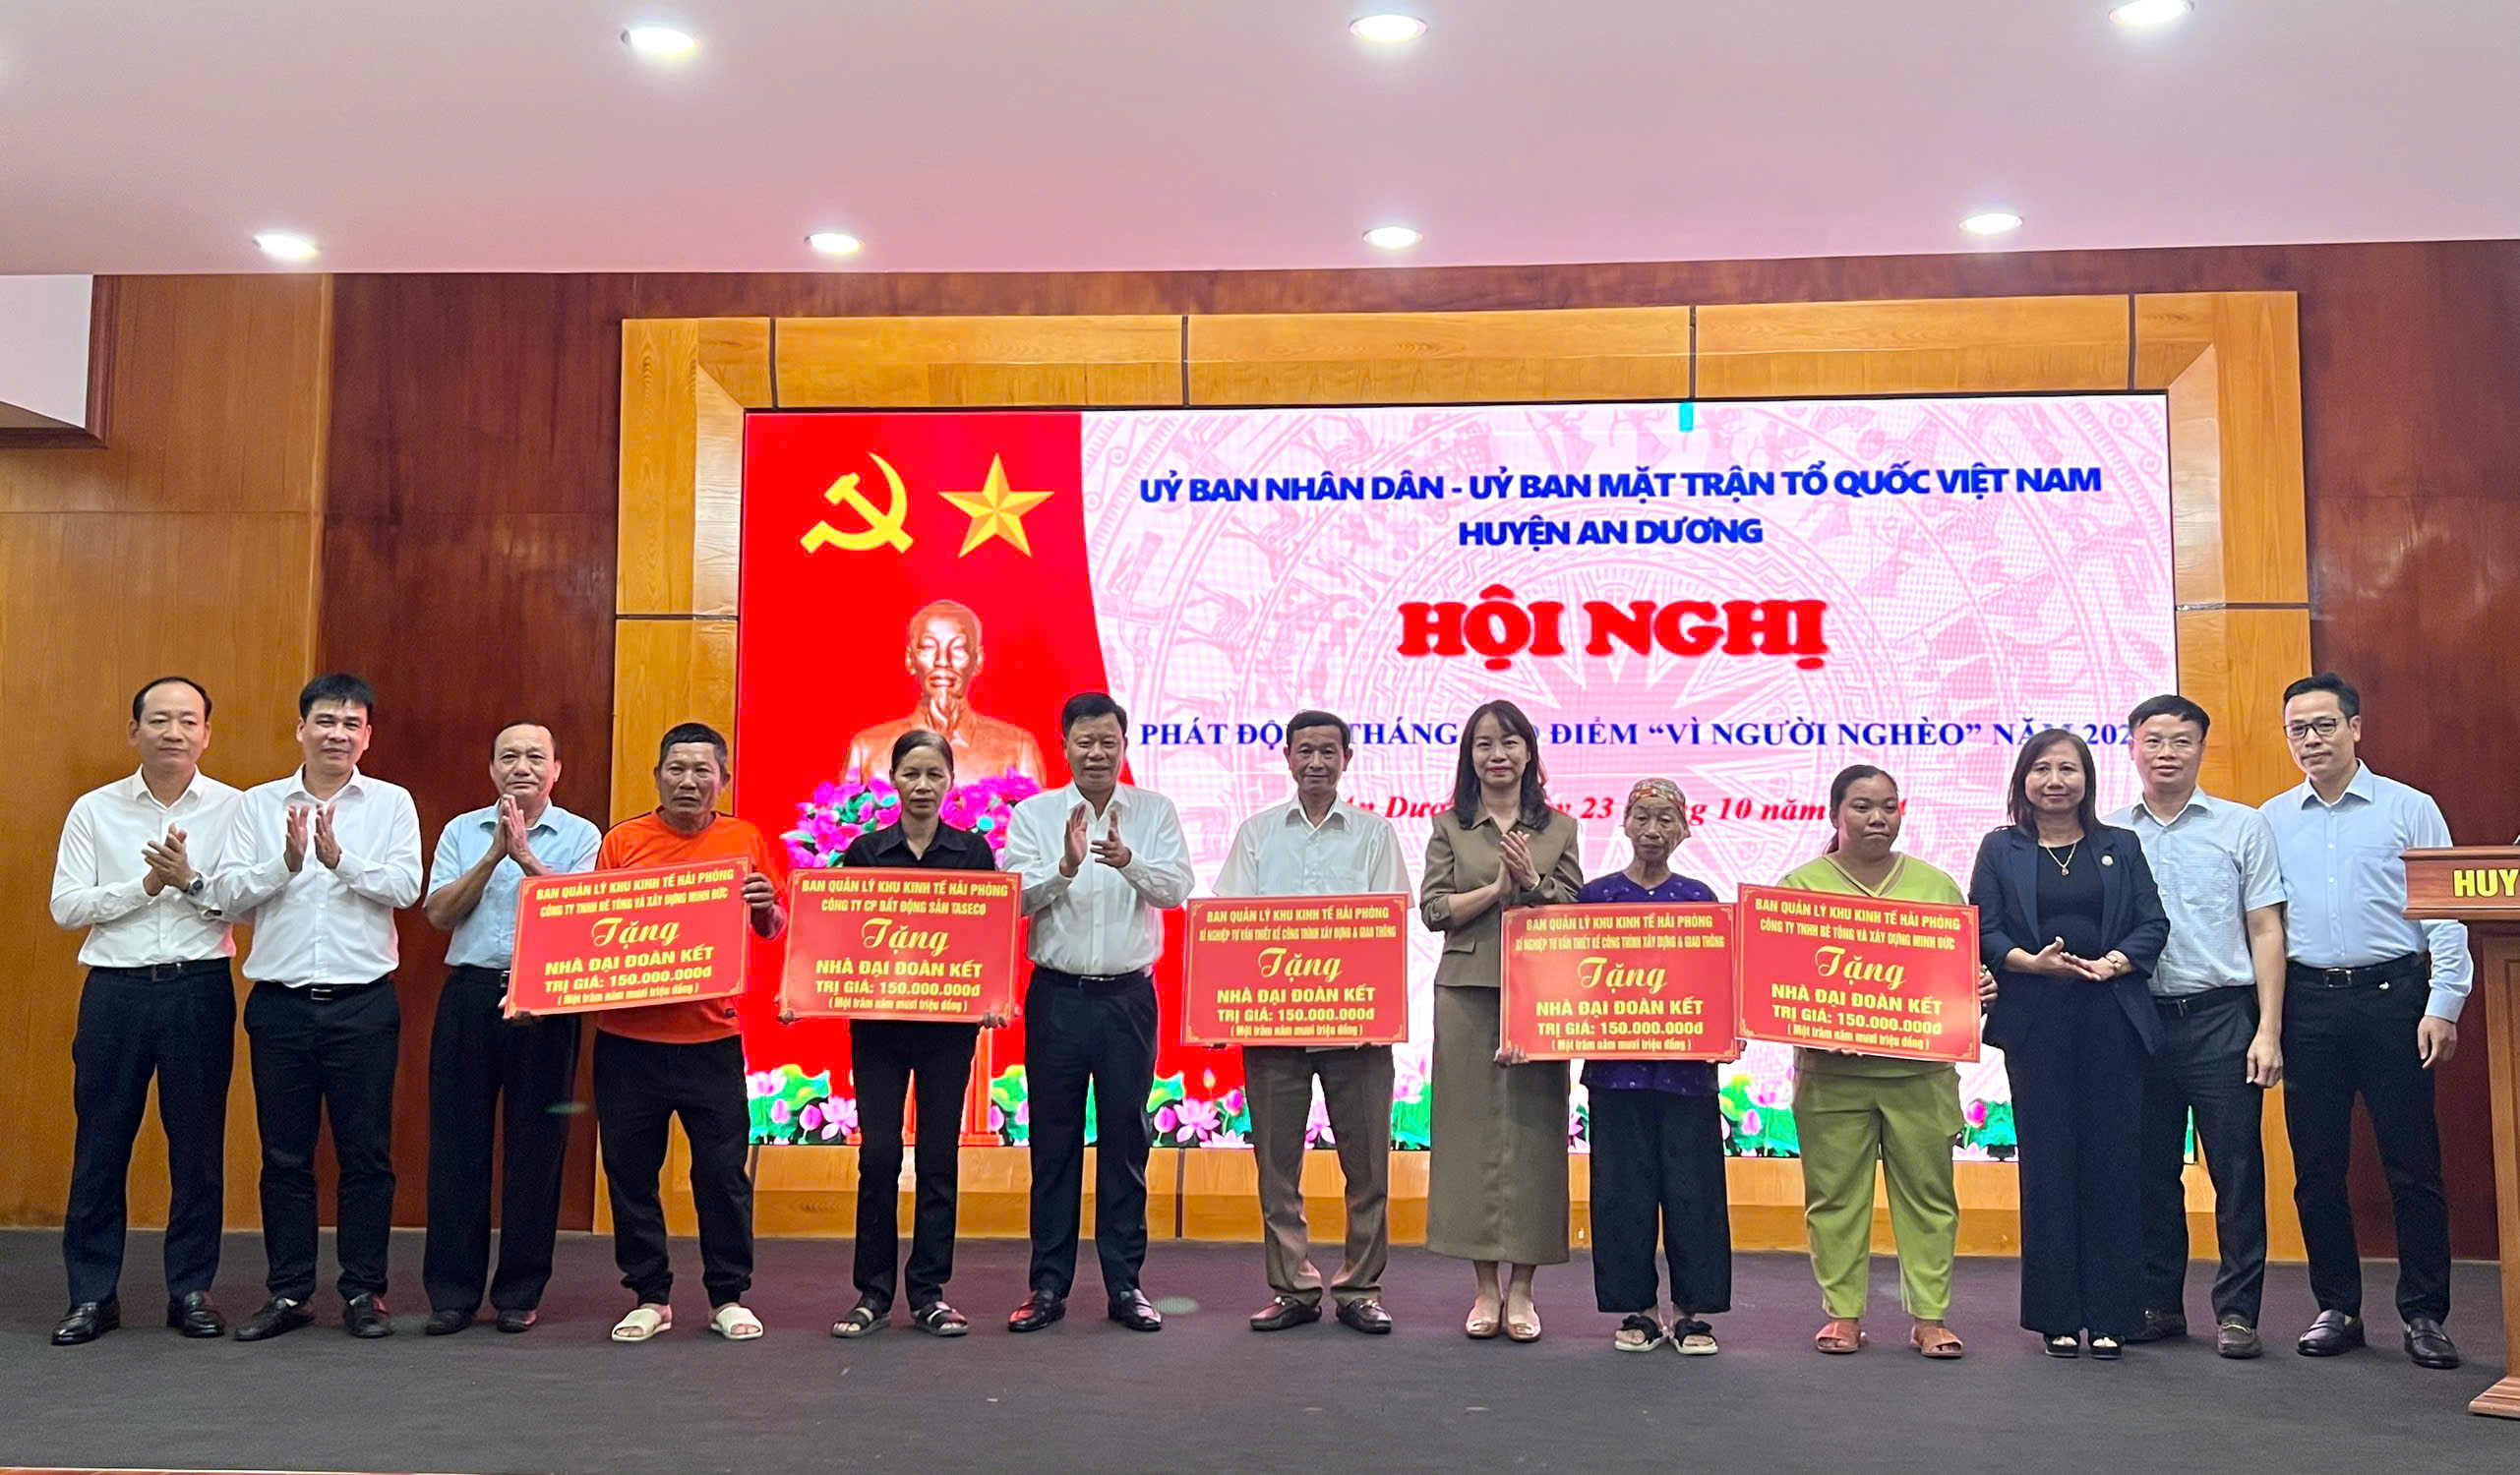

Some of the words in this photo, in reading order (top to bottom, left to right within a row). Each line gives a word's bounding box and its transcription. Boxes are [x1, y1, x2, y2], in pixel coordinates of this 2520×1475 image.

[1140, 469, 1183, 503] UỶ
[1188, 477, 1259, 502] BAN
[1265, 471, 1365, 502] NHÂN
[1371, 469, 1445, 501] DÂN
[1469, 465, 1515, 501] UỶ
[1519, 473, 1592, 500] BAN
[1598, 466, 1677, 504] MẶT
[1680, 464, 1775, 503] TRẬN
[1780, 460, 1829, 497] TỔ
[1832, 460, 1931, 499] QUỐC
[1935, 461, 2010, 501] VIỆT
[2015, 467, 2102, 494] NAM
[1459, 514, 1571, 552] HUYỆN
[1576, 519, 1629, 546] AN
[1635, 515, 1764, 545] DƯƠNG
[1397, 583, 1566, 672] HỘI
[1582, 598, 1830, 672] NGHỊ
[1140, 717, 1229, 745] PHÁT
[1237, 719, 1288, 750] ĐỘ
[1551, 716, 1638, 745] ĐIỂM
[1712, 716, 1827, 746] NGƯỜI
[1993, 717, 2073, 745] NĂ
[2083, 723, 2130, 745] 202
[1580, 796, 1613, 818] 23
[1720, 797, 1752, 820] 10
[1761, 798, 1827, 821] năm
[536, 888, 560, 901] BAN
[561, 882, 592, 899] QUẢN
[593, 881, 607, 895] LÝ
[609, 881, 631, 894] KHU
[632, 877, 660, 891] KINH
[662, 873, 676, 888] TẾ
[677, 870, 696, 886] HẢI
[696, 868, 735, 884] PHÒNG
[802, 880, 826, 892] BAN
[828, 877, 860, 893] QUẢN
[862, 878, 875, 893] LÝ
[877, 881, 901, 894] KHU
[902, 881, 930, 894] KINH
[932, 880, 947, 895] TẾ
[948, 881, 968, 896] HẢI
[970, 881, 1008, 897] PHÒNG
[1207, 911, 1228, 922] BAN
[1230, 907, 1257, 923] QUẢN
[1259, 908, 1271, 921] LÝ
[1273, 910, 1293, 921] KHU
[1295, 909, 1320, 920] KINH
[1322, 905, 1334, 920] TẾ
[1336, 905, 1352, 920] HẢI
[1354, 905, 1390, 919] PHÒNG
[1527, 919, 1547, 931] BAN
[1549, 914, 1576, 931] QUẢN
[1579, 914, 1590, 929] LÝ
[1592, 916, 1613, 929] KHU
[1616, 916, 1641, 928] KINH
[1643, 913, 1656, 928] TẾ
[1656, 913, 1676, 928] HẢI
[1677, 913, 1712, 928] PHÒNG
[1755, 898, 1778, 913] BAN
[1780, 900, 1811, 915] QUẢN
[1814, 903, 1827, 917] LÝ
[1830, 906, 1852, 920] KHU
[1854, 909, 1882, 923] KINH
[1884, 910, 1897, 925] TẾ
[1899, 911, 1919, 927] HẢI
[1921, 914, 1961, 930] PHÒNG
[591, 917, 680, 950] Tặng
[862, 917, 949, 957] Tặng
[545, 957, 584, 975] NHÀ
[588, 956, 620, 973] ĐẠI
[625, 950, 676, 969] ĐOÀN
[681, 944, 714, 963] KẾT
[816, 957, 854, 974] NHÀ
[859, 960, 889, 979] ĐẠI
[895, 960, 944, 976] ĐOÀN
[949, 960, 983, 978] KẾT
[1258, 947, 1342, 983] Tặng
[1815, 945, 1906, 990] Tặng
[544, 979, 570, 993] TRỊ
[572, 974, 604, 990] GIÁ:
[610, 966, 712, 987] 150.000.000đ
[815, 980, 839, 995] TRỊ
[843, 979, 873, 994] GIÁ:
[879, 981, 981, 999] 150.000.000đ
[1578, 957, 1667, 994] Tặng
[1217, 986, 1252, 1004] NHÀ
[1257, 989, 1287, 1006] ĐẠI
[1290, 985, 1339, 1003] ĐOÀN
[1344, 984, 1376, 1002] KẾT
[1536, 999, 1573, 1015] NHÀ
[1579, 1001, 1608, 1018] ĐẠI
[1613, 997, 1664, 1015] ĐOÀN
[1670, 996, 1704, 1015] KẾT
[1771, 983, 1810, 1002] NHÀ
[1815, 988, 1846, 1008] ĐẠI
[1851, 992, 1902, 1012] ĐOÀN
[1908, 996, 1943, 1015] KẾT
[1218, 1009, 1240, 1024] TRỊ
[1243, 1007, 1273, 1022] GIÁ:
[1278, 1007, 1375, 1023] 150.000.000đ
[1537, 1023, 1560, 1036] TRỊ
[1566, 1020, 1595, 1034] GIÁ:
[1600, 1022, 1704, 1035] 150.000.000đ
[1772, 1004, 1797, 1022] TRỊ
[1801, 1007, 1832, 1024] GIÁ:
[1837, 1013, 1943, 1034] 150.000.000đ
